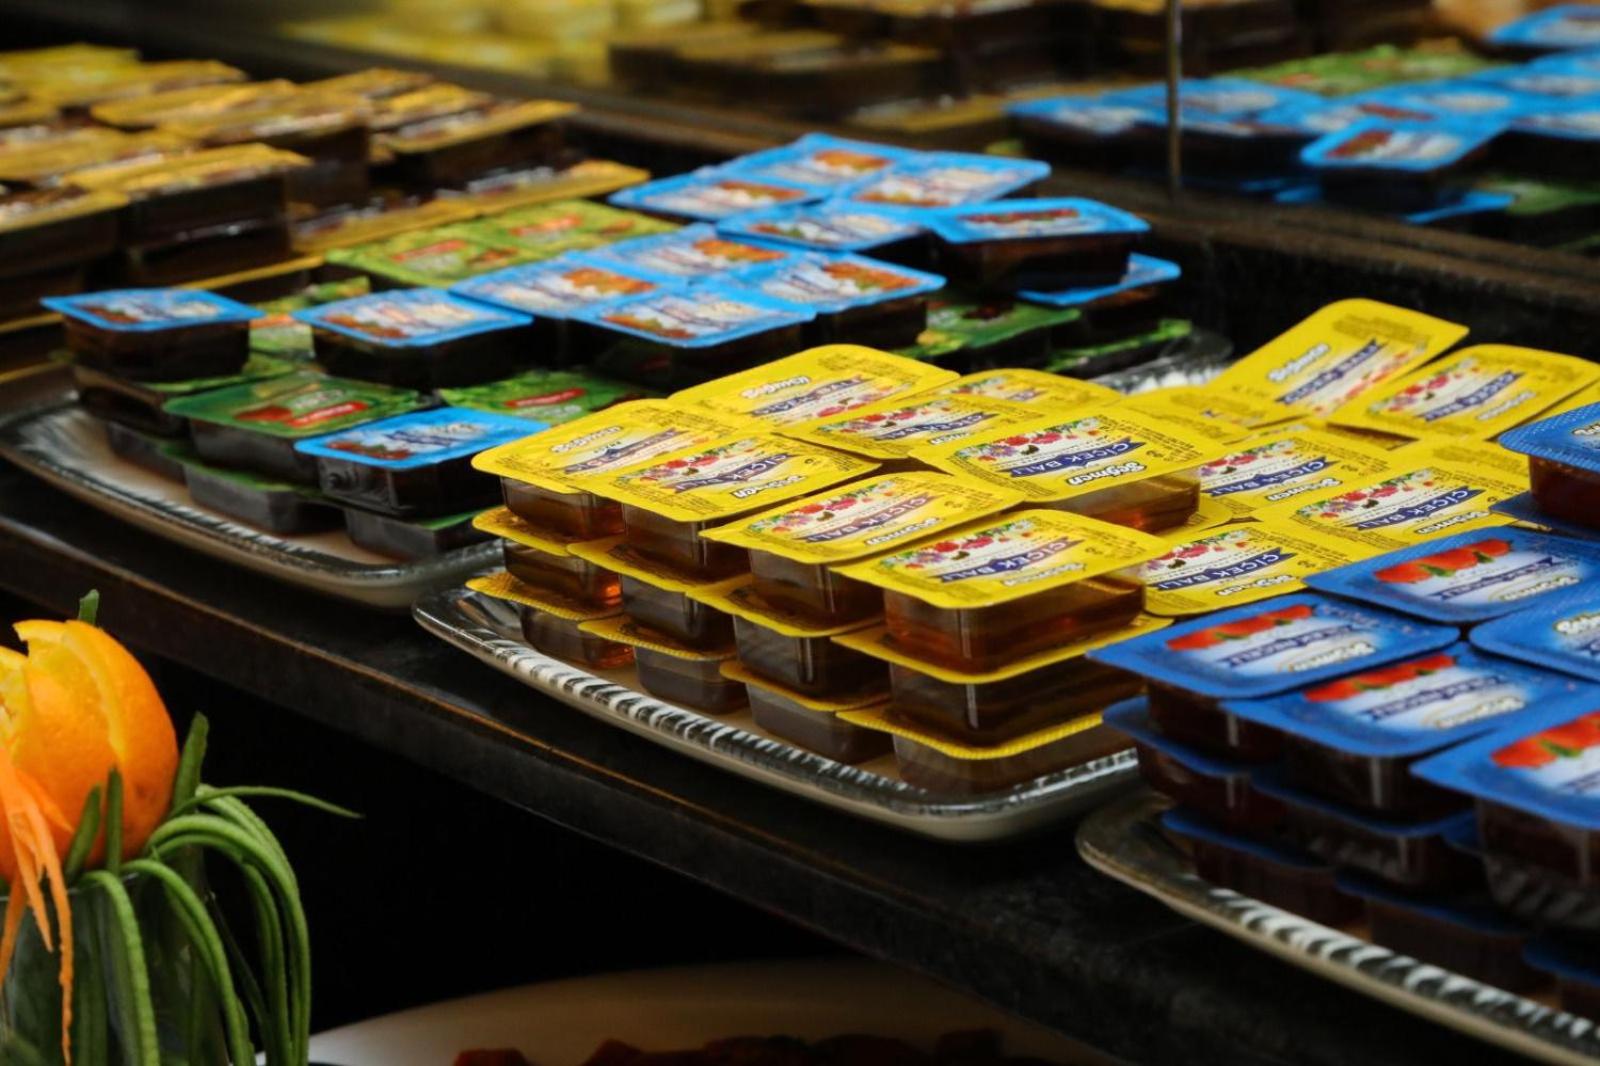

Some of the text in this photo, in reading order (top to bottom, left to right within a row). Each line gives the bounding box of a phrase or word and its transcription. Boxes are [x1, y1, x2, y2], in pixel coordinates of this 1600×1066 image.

[1011, 442, 1130, 475] ÇİÇEK BALI
[1406, 488, 1469, 516] ÇİÇEK
[1157, 553, 1280, 590] ÇİÇEK BALI
